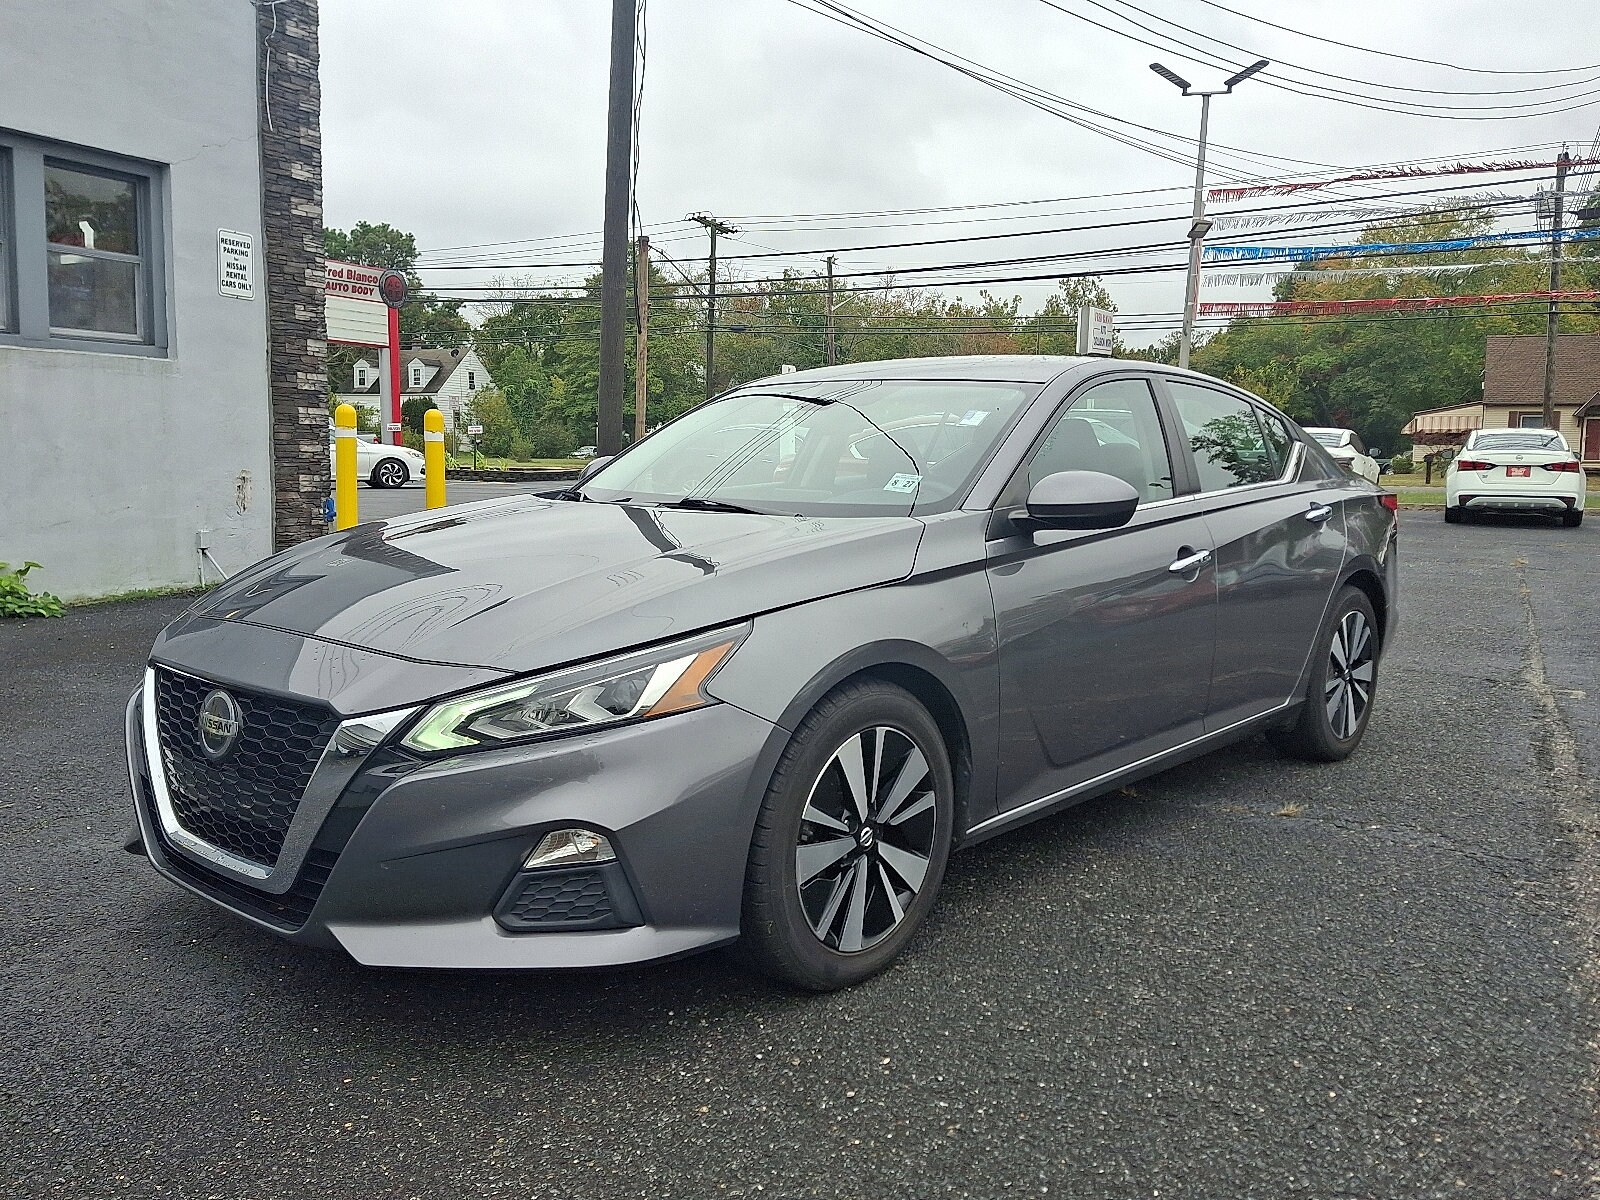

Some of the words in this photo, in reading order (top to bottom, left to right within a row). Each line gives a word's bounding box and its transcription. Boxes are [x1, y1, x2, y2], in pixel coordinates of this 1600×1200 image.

[220, 237, 251, 249] RESERVED
[223, 246, 249, 257] PARKING
[226, 261, 247, 271] NISSAN
[225, 271, 248, 281] RENTAL
[346, 269, 379, 284] Blanco
[221, 279, 237, 288] CARS
[237, 282, 252, 291] ONLY
[325, 281, 349, 292] AUTO
[351, 284, 375, 296] BODY
[902, 480, 916, 488] 27
